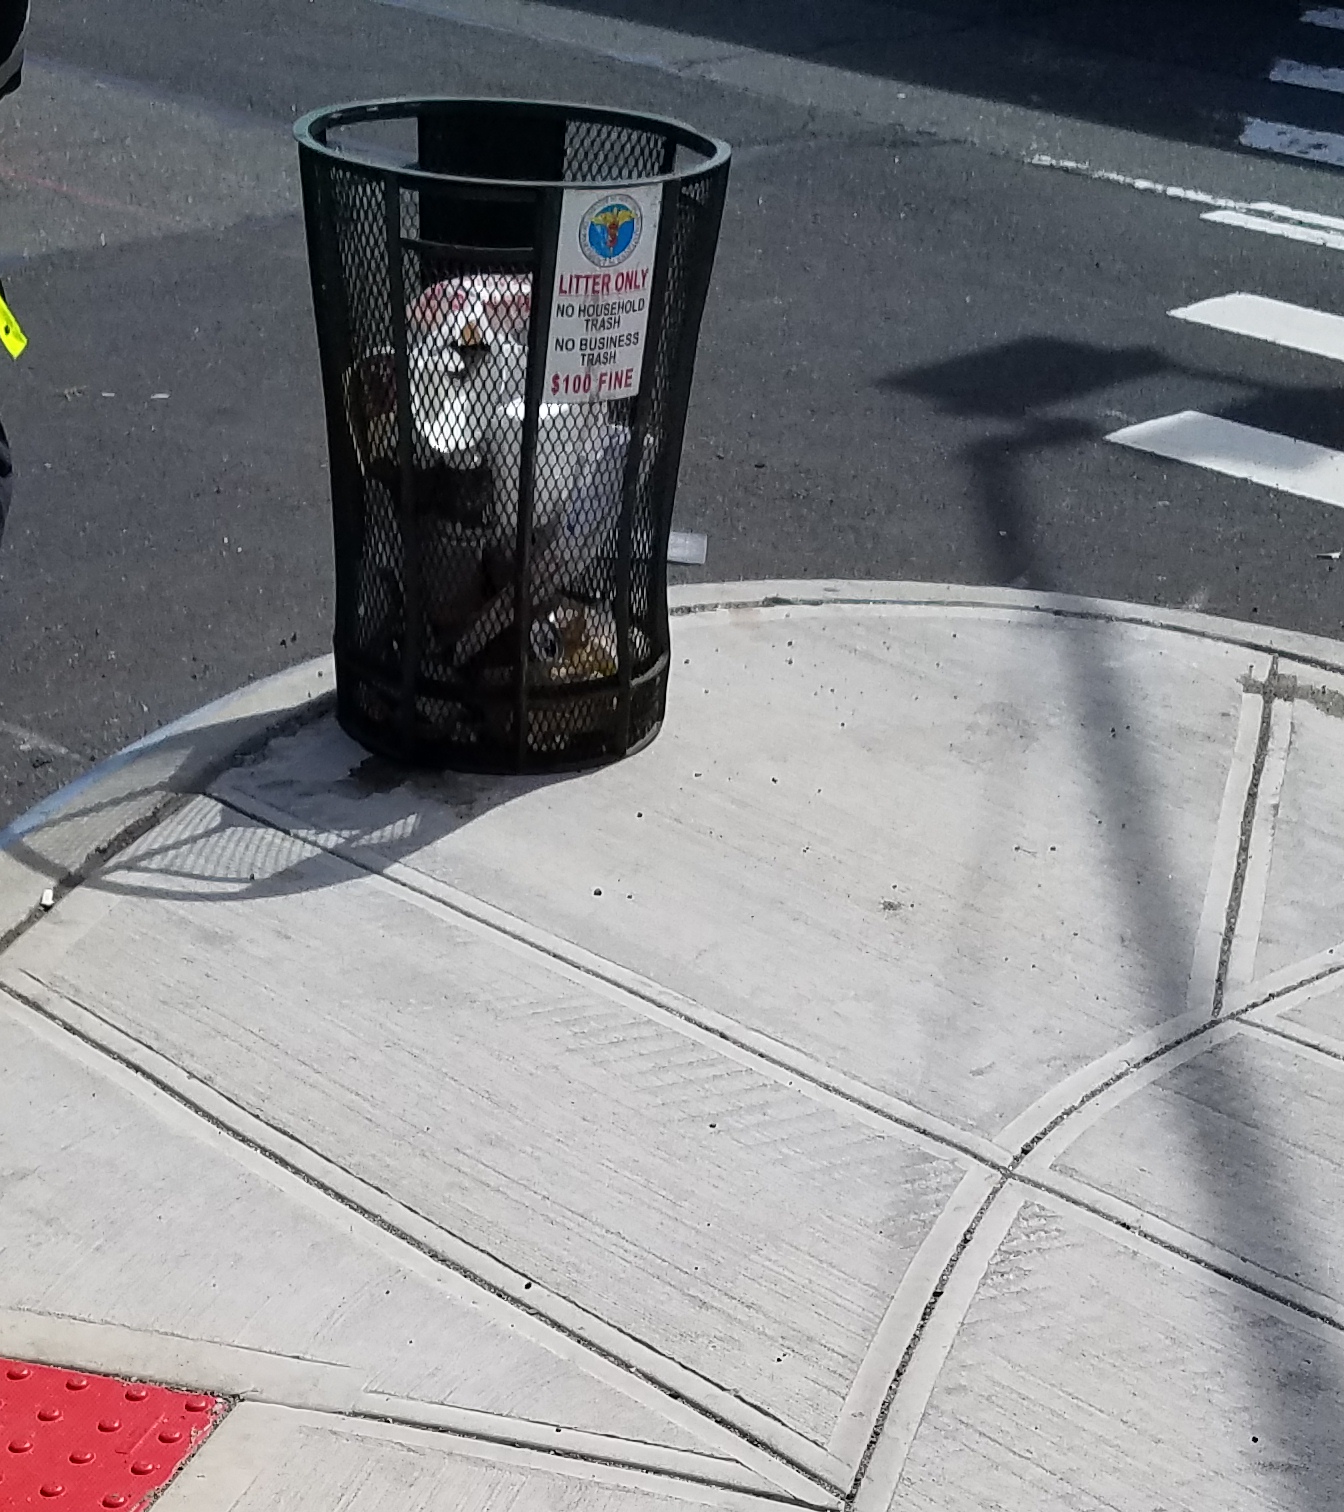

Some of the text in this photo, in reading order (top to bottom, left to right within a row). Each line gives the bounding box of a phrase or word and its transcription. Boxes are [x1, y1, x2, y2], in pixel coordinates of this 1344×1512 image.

[558, 268, 648, 296] LITTER ONLY
[556, 298, 645, 318] NO HOUSEHOLD
[584, 315, 621, 332] TRASH
[555, 332, 639, 352] NO BUSINESS
[580, 351, 616, 367] TRASH
[551, 368, 634, 395] $100 FINE
